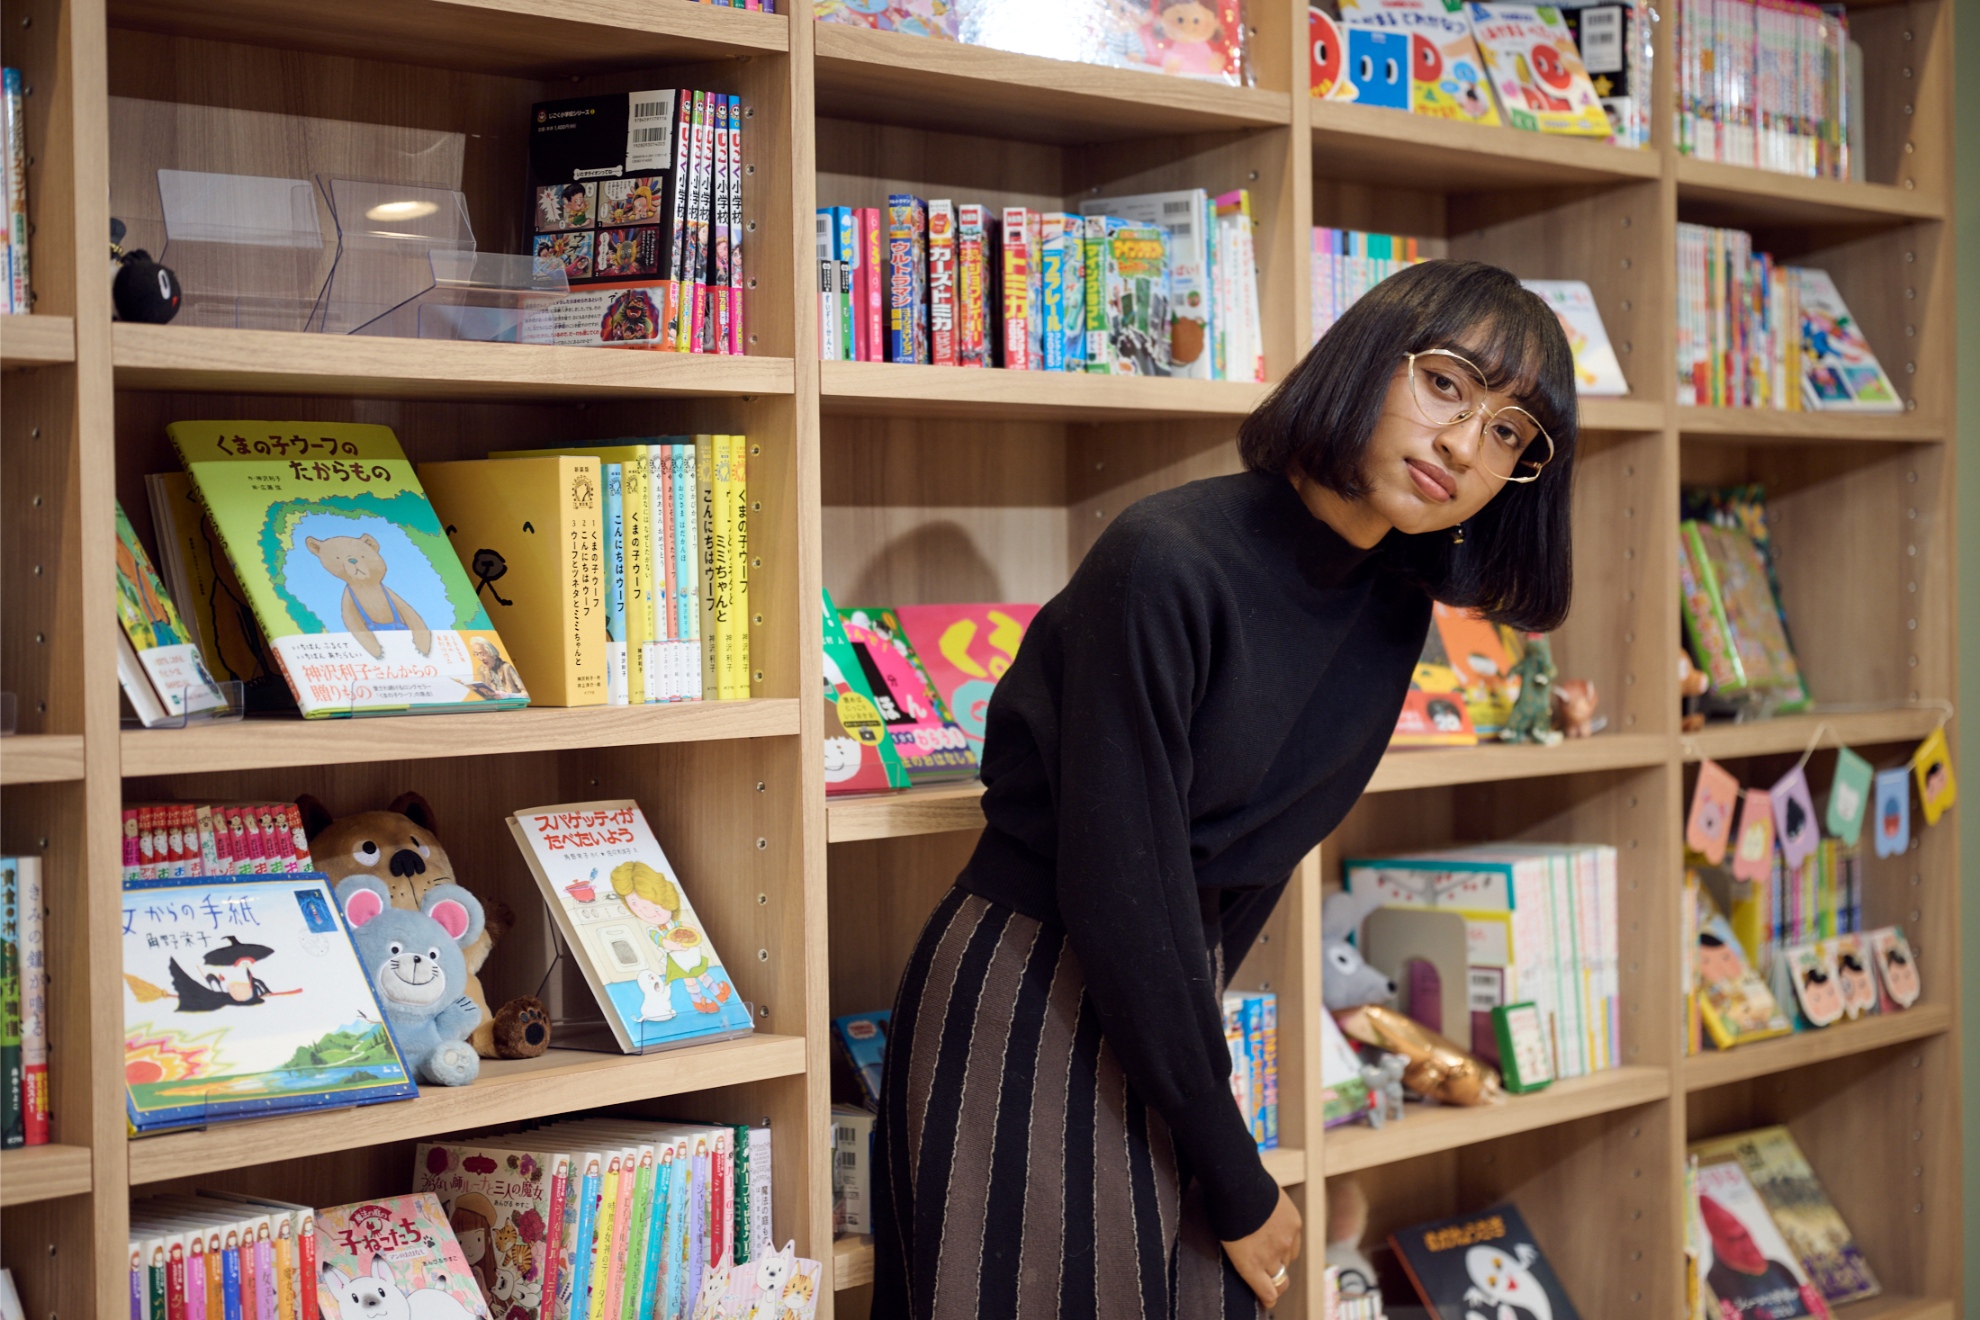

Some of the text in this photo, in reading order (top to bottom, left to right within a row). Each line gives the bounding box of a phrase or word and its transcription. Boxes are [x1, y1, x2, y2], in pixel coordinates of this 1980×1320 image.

[890, 241, 912, 308] ウルトラマン
[1004, 250, 1028, 319] トミカ
[1043, 256, 1062, 332] プラレール
[216, 434, 358, 456] くまの子ウーフの
[290, 459, 391, 482] たからもの
[631, 512, 641, 600] くまの子ウーフ
[703, 489, 715, 611] こんにちはウーフ
[738, 489, 749, 594] くまの子ウーフ
[581, 530, 590, 617] こんにちはウーフ
[591, 530, 600, 608] くまの子ウーフ
[614, 515, 625, 612] こんにちはウーフ
[716, 534, 728, 623] ミミちゃんと
[571, 530, 582, 666] ウーフとツネタとミミちゃんと
[292, 642, 349, 651] いちばん ふるくて
[296, 651, 363, 660] いちばん あたらしい
[302, 663, 438, 683] 神沢利子さんからの
[309, 684, 373, 703] 贈りもの
[534, 806, 635, 833] スパゲッティが
[544, 827, 635, 851] たべたいよう
[563, 851, 589, 861] 角野栄子
[26, 883, 44, 1037] きみの鐘が鳴る
[146, 931, 211, 950] 角野栄子
[420, 1173, 544, 1201] うらない師ルーナと三人の魔女
[493, 1199, 530, 1209] あんびる やすこ
[338, 1217, 422, 1256] 子ねこたち
[422, 1256, 459, 1267] あんびるやすこ
[595, 1200, 616, 1319] 時間の女神のティータイム
